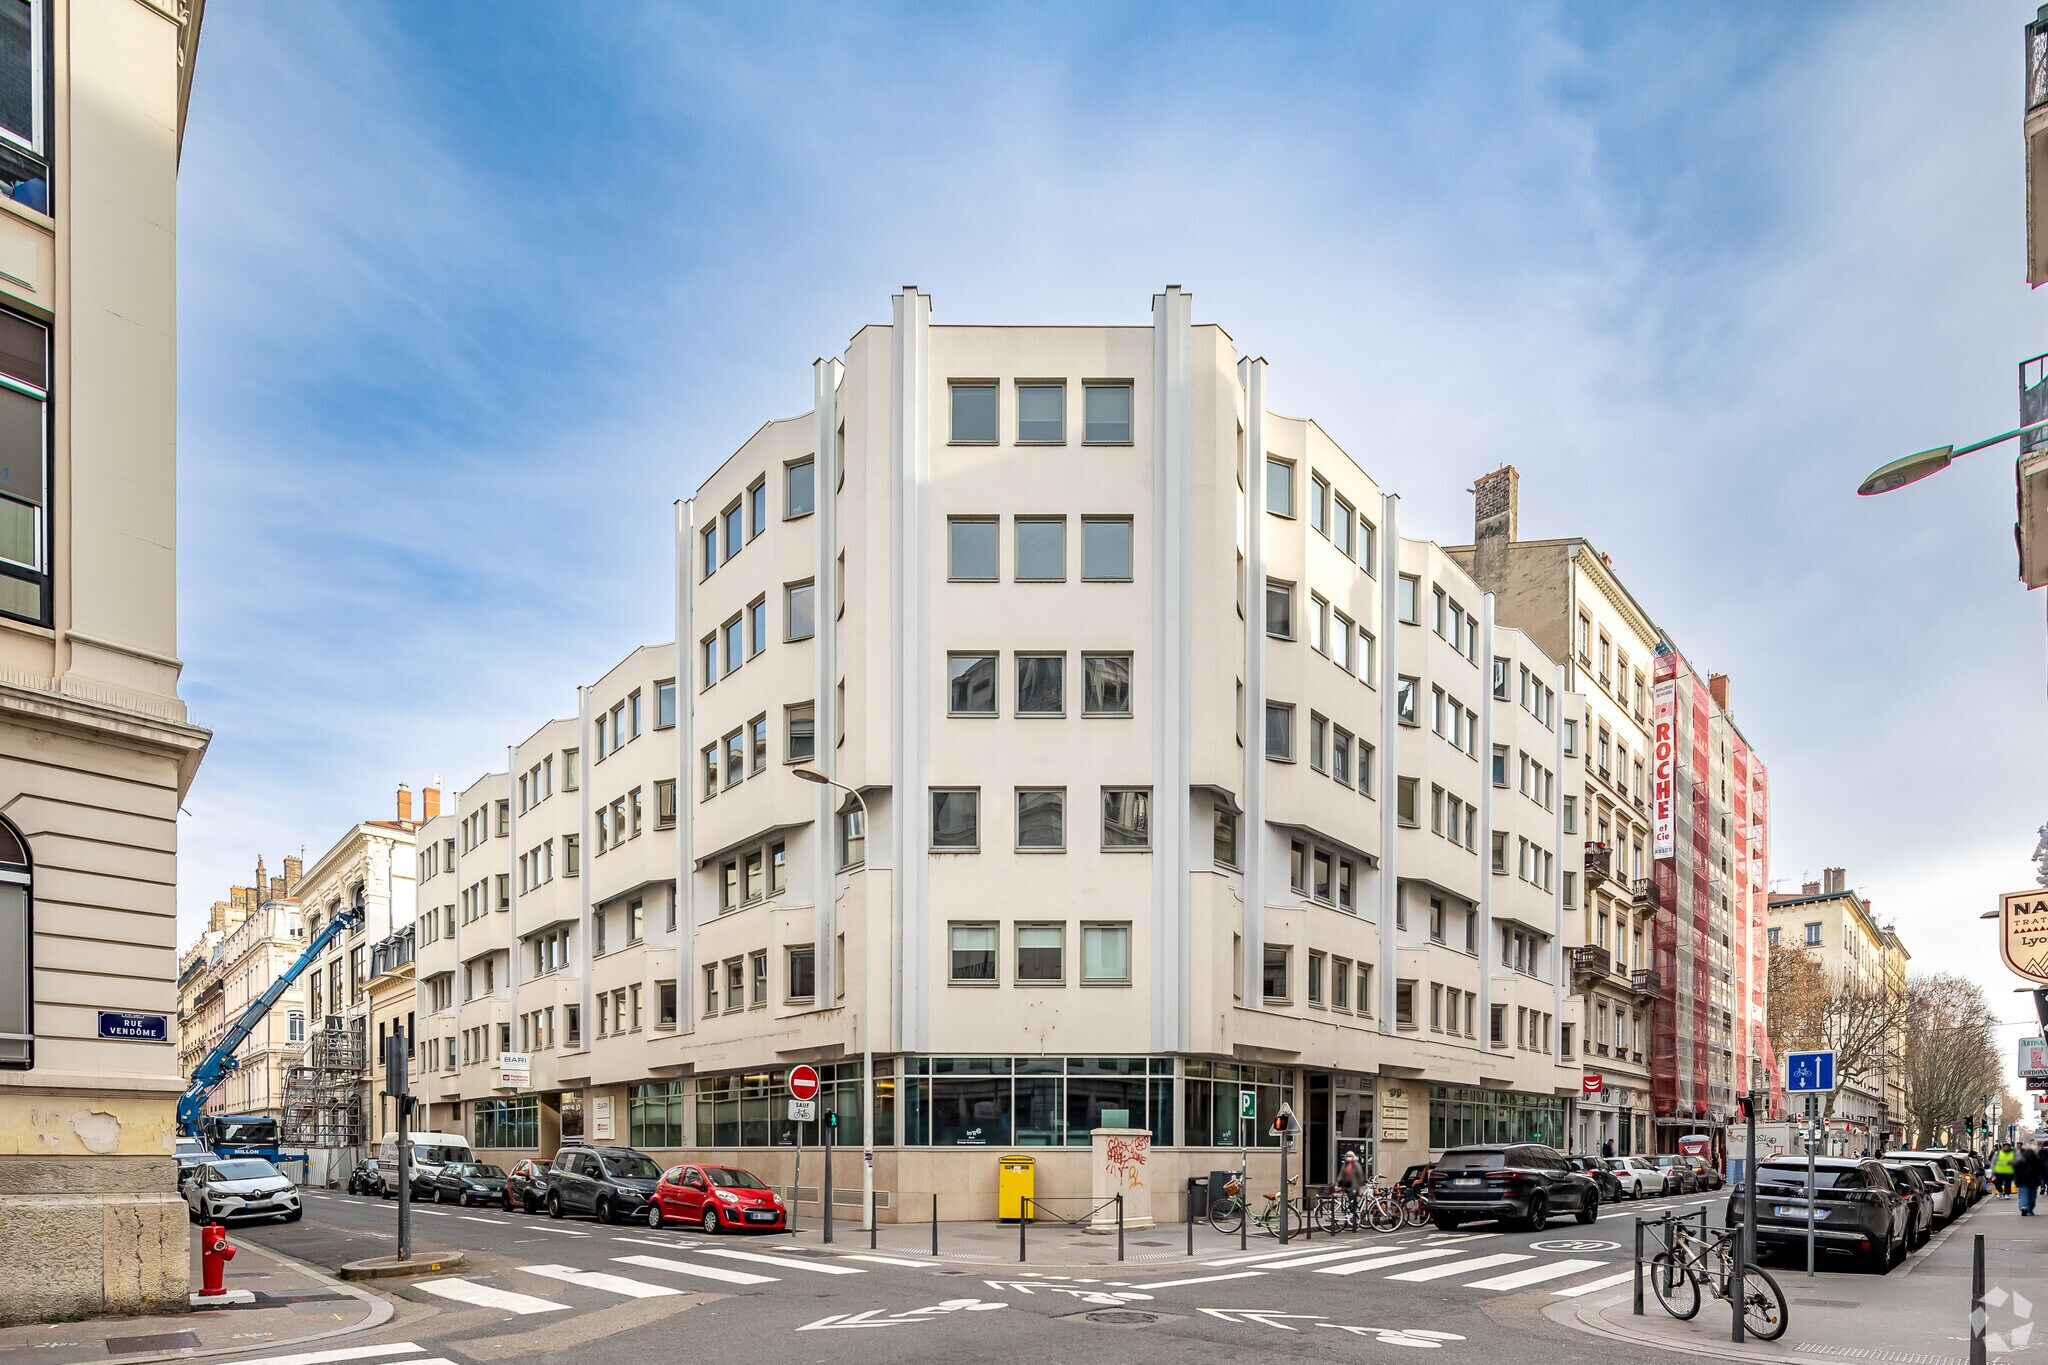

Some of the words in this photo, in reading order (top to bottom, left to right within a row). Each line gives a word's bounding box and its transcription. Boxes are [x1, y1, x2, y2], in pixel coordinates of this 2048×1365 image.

[1656, 722, 1671, 820] ROCHE
[1659, 824, 1667, 832] et
[2014, 900, 2048, 916] NA
[2014, 917, 2047, 926] TRAT
[124, 1019, 143, 1027] RUE
[110, 1027, 157, 1037] VENDÔME
[1243, 1094, 1251, 1112] P
[1546, 1241, 1604, 1249] 30
